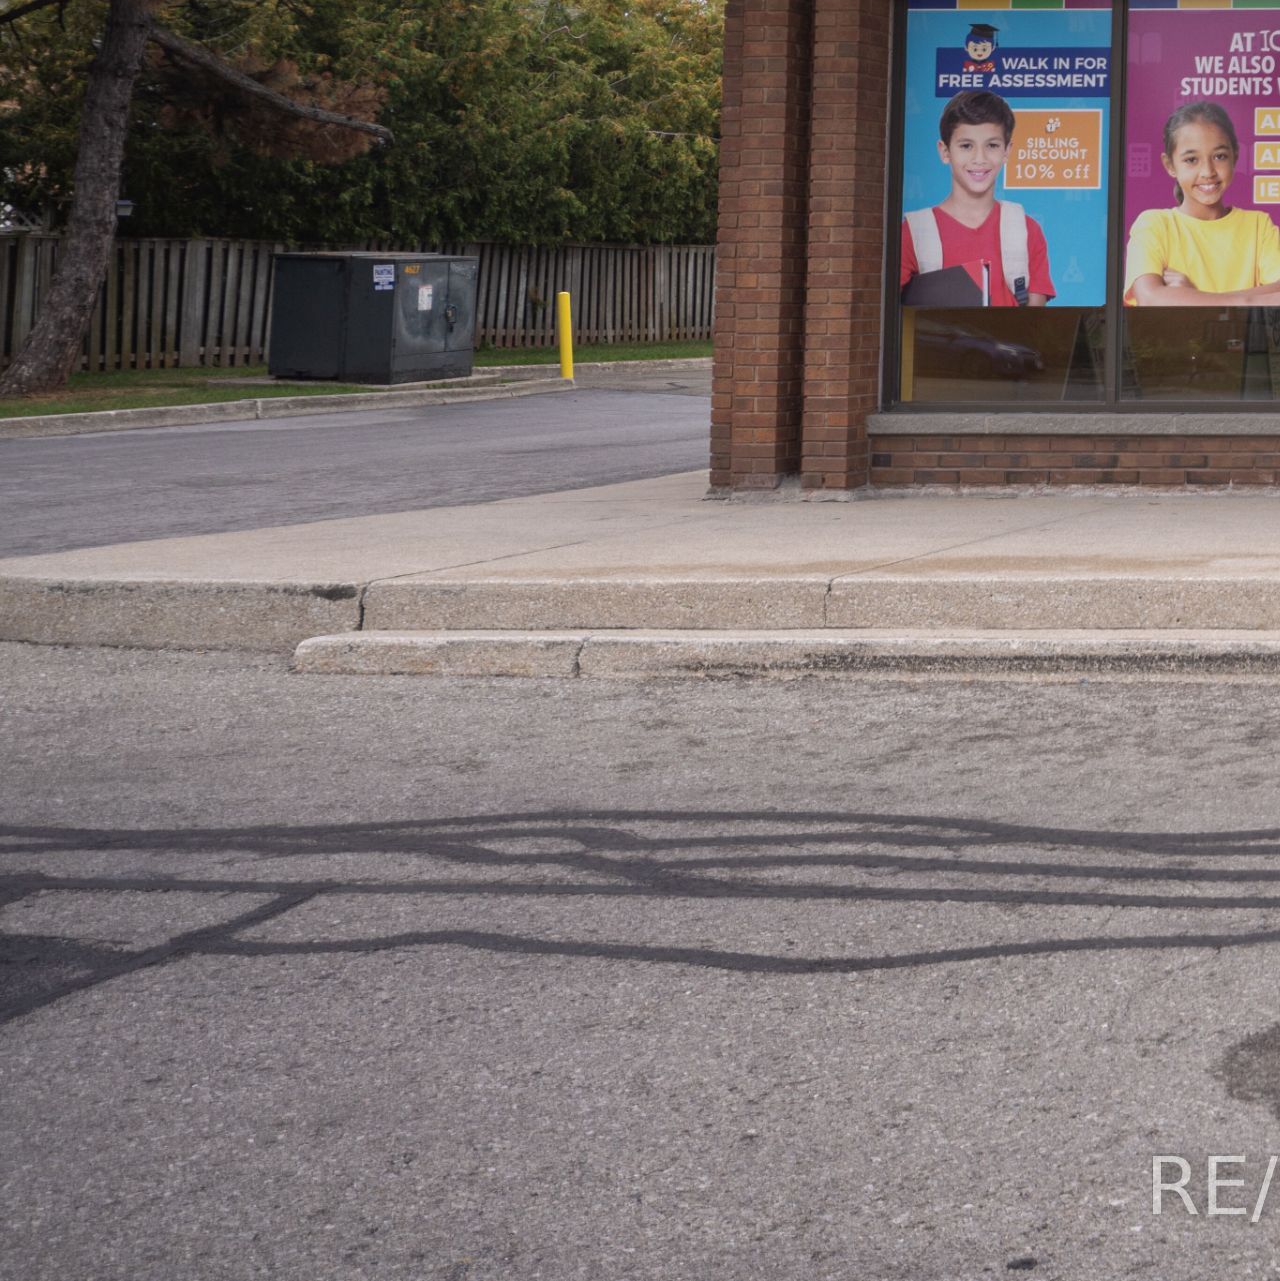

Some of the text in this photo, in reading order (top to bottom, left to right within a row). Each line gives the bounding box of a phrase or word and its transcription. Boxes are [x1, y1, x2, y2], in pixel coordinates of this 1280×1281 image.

[1230, 33, 1255, 52] AT
[1002, 57, 1107, 70] WALK IN FOR
[1195, 56, 1224, 73] WE
[1228, 56, 1275, 73] ALSO
[939, 74, 1107, 87] FREE ASSESSMENT
[1181, 77, 1272, 95] STUDENTS
[1026, 138, 1079, 148] SIBLING
[1018, 149, 1087, 160] DISCOUNT
[1016, 165, 1091, 179] 10% off
